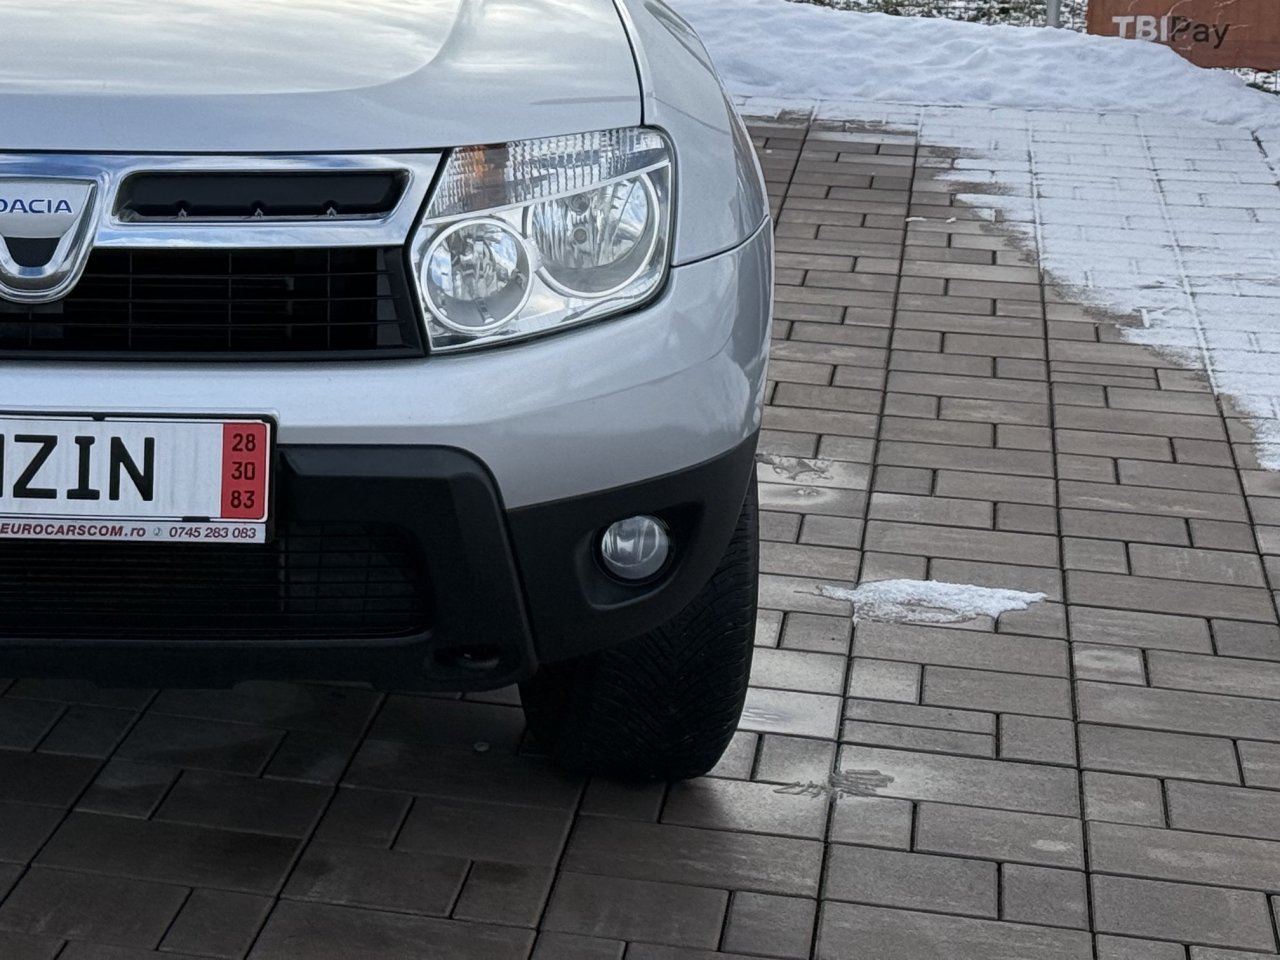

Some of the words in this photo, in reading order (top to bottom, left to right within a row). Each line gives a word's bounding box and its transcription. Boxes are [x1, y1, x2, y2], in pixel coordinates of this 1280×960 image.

[231, 433, 256, 452] 28
[231, 461, 256, 480] 30
[230, 490, 255, 509] 83
[169, 526, 202, 538] 0745
[204, 527, 229, 539] 283
[232, 527, 257, 539] 083
